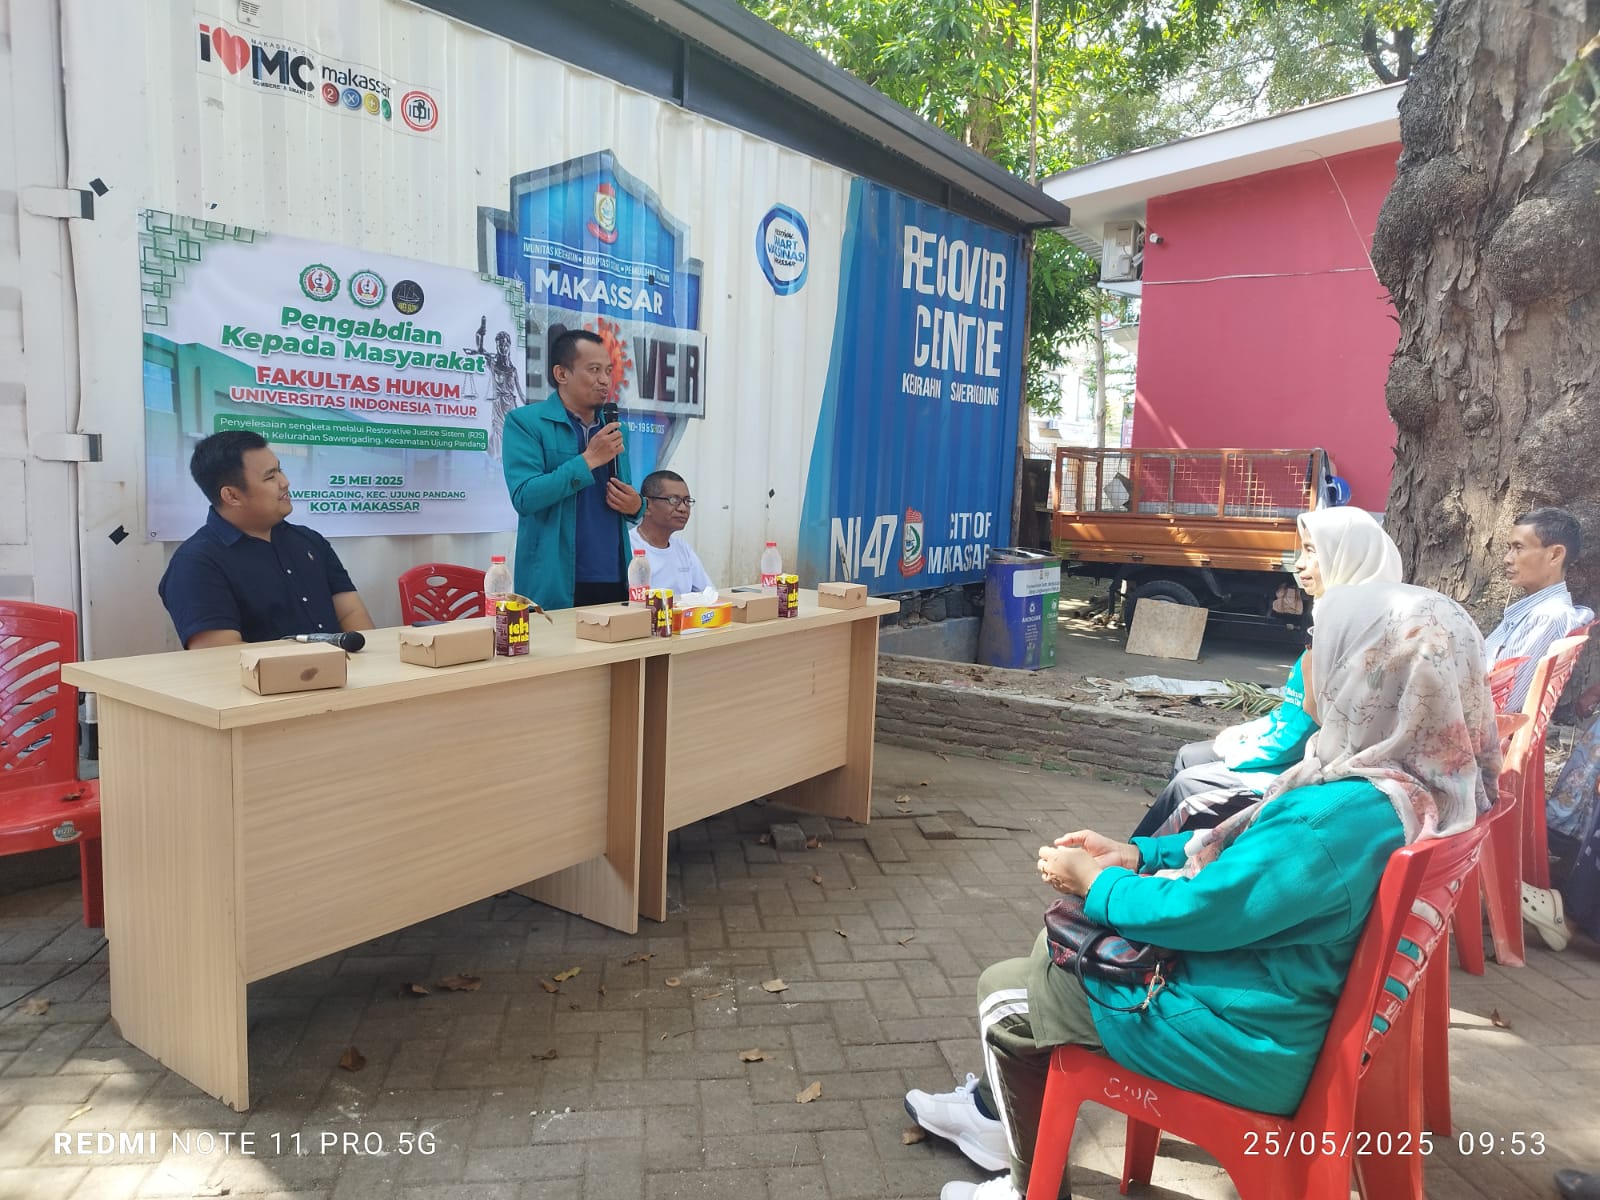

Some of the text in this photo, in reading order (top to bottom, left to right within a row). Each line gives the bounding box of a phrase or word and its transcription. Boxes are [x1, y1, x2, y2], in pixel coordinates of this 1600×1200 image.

[252, 45, 315, 91] MC
[321, 66, 391, 98] makassar
[535, 268, 663, 315] MAKASSAR
[281, 306, 442, 345] Pengabdian
[221, 325, 486, 372] Kepada Masyarakat
[914, 305, 1003, 378] CENTRE
[257, 366, 460, 398] FAKULTAS HUKUM
[231, 388, 477, 416] UNIVERSITAS INDONESIA TIMUR
[220, 417, 287, 429] Penyelesaian
[288, 422, 331, 432] sengketa
[333, 424, 364, 433] melalui
[366, 426, 411, 435] Restorative
[412, 428, 440, 437] Justice
[272, 431, 320, 441] Kelurahan
[385, 437, 429, 446] Kecamatan
[431, 439, 453, 448] Ujung
[454, 440, 486, 449] Pandang
[329, 475, 403, 486] 25 MEI 2025
[366, 491, 388, 499] KEC.
[390, 491, 420, 499] UJUNG
[310, 501, 420, 512] KOTA MAKASSAR
[974, 511, 992, 539] OF
